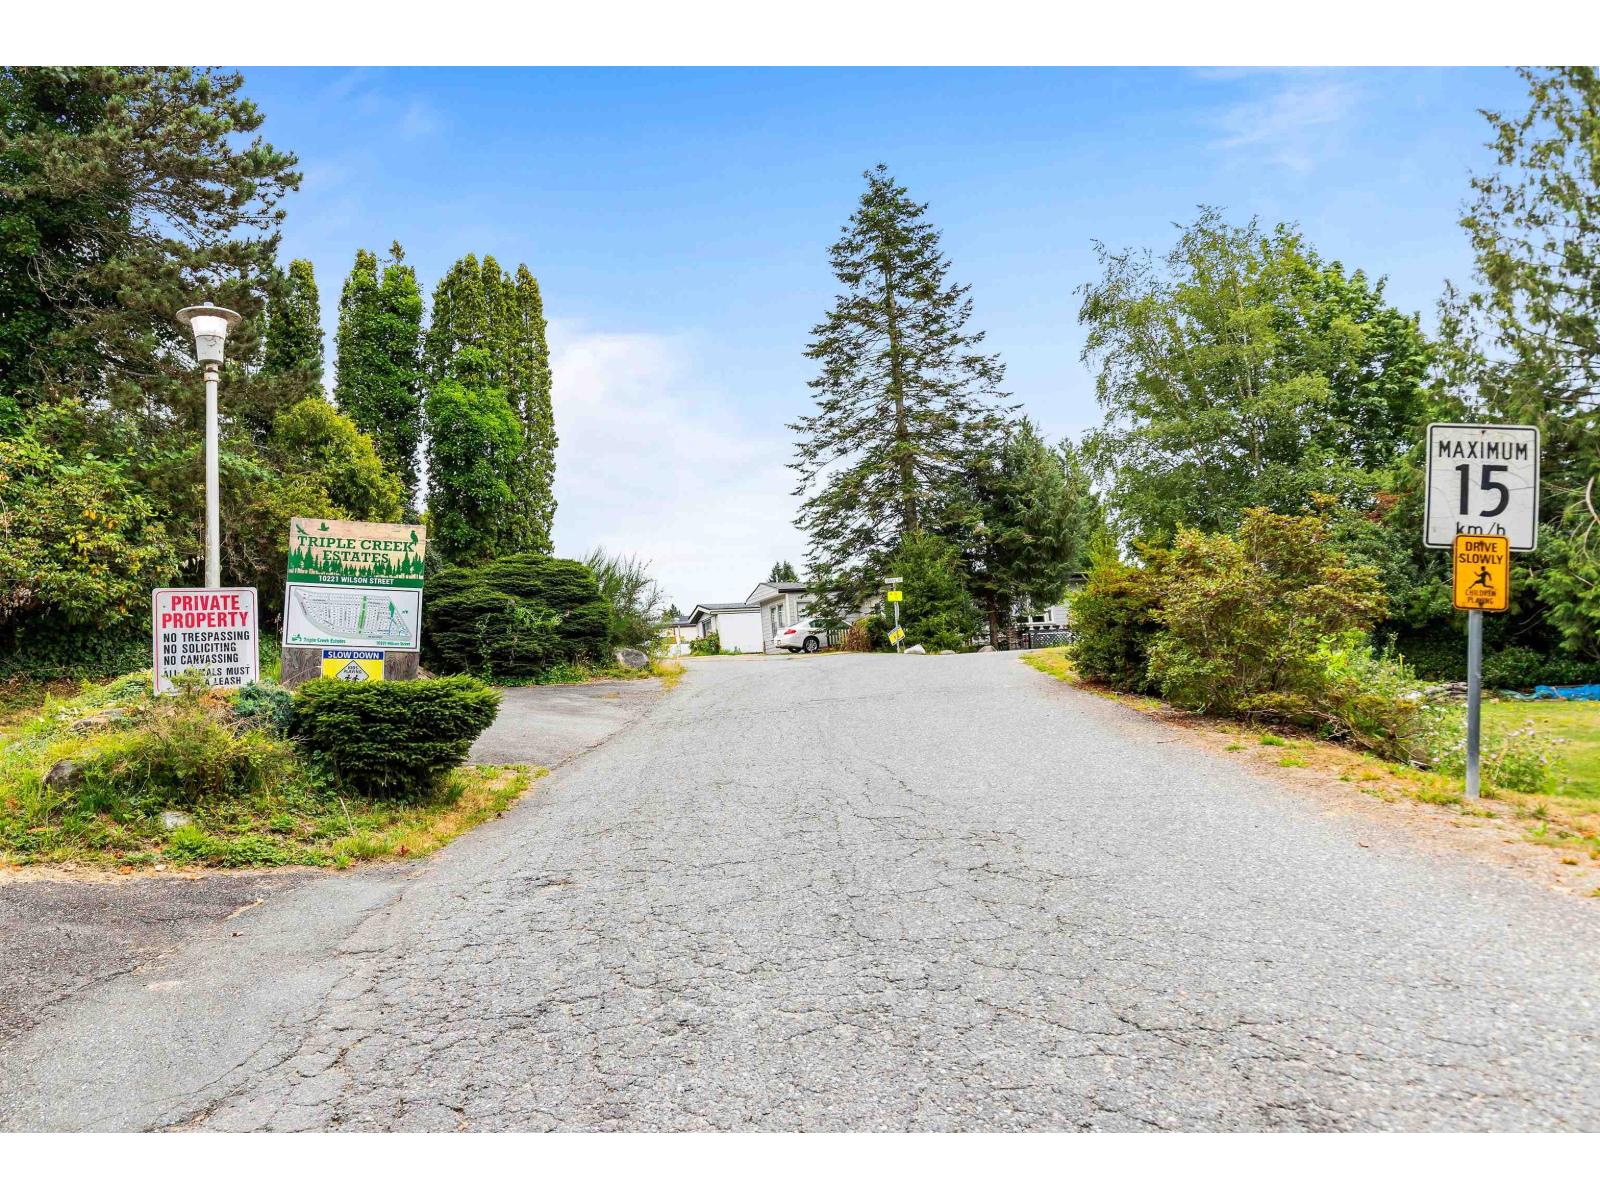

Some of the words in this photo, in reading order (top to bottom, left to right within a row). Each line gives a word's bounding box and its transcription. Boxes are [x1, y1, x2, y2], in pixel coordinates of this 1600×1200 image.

[1438, 440, 1528, 461] MAXIMUM
[1455, 463, 1510, 518] 15
[1455, 521, 1506, 536] km/h
[297, 535, 355, 550] TRIPLE
[360, 539, 414, 553] CREEK
[1464, 541, 1497, 553] DRIVE
[322, 549, 389, 564] ESTATES
[1459, 553, 1504, 565] SLOWLY
[319, 575, 339, 583] 10221
[341, 576, 368, 584] WILSON
[369, 577, 395, 585] STREET
[171, 595, 240, 611] PRIVATE
[162, 612, 248, 629] PROPERTY
[163, 632, 177, 643] NO
[181, 630, 250, 642] TRESPASSING
[163, 643, 177, 654] NO
[182, 641, 237, 654] SOLICITING
[163, 655, 177, 666] NO
[180, 653, 239, 665] CANVASSING
[328, 650, 352, 659] SLOW
[353, 651, 380, 660] DOWN
[226, 666, 251, 676] MUST
[213, 676, 242, 686] LEASH
